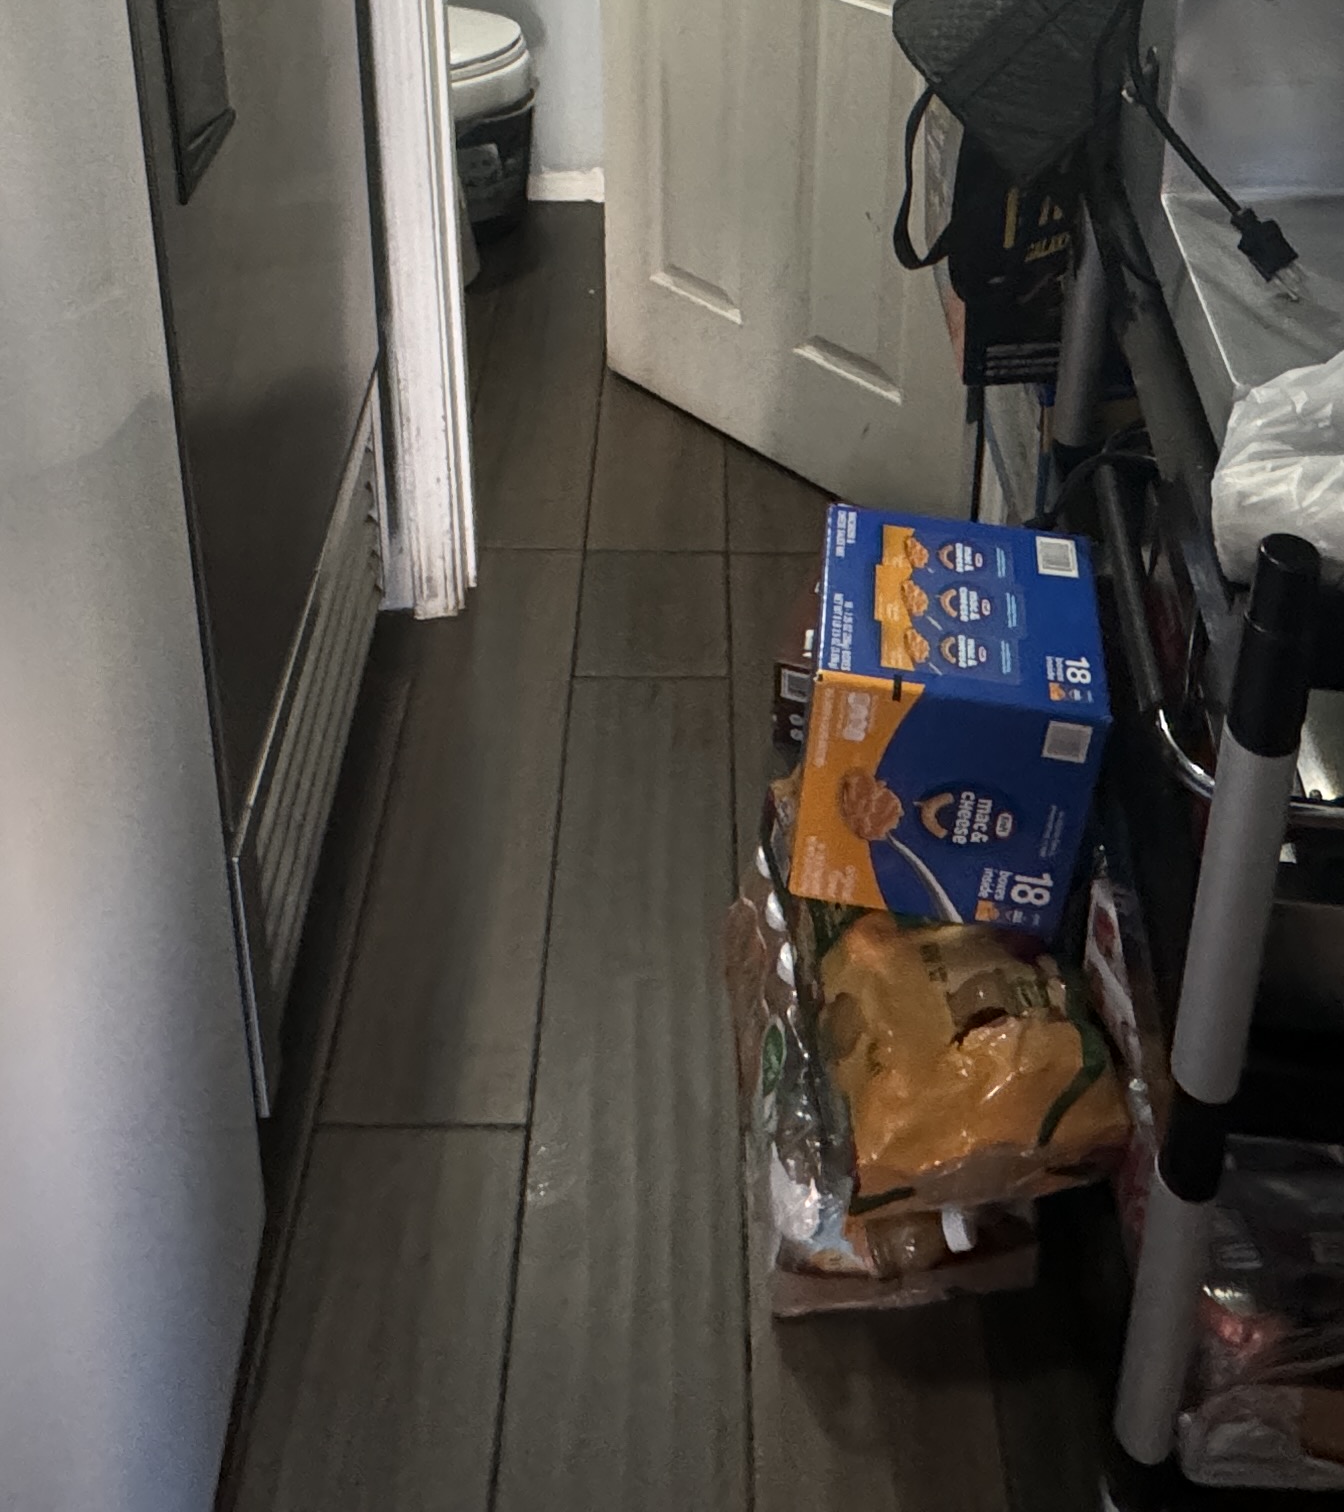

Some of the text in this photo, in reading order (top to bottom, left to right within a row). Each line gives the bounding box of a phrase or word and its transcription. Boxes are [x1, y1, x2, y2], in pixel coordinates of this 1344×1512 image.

[1065, 656, 1092, 684] 18
[978, 867, 996, 898] inside
[994, 870, 1013, 901] boxes
[1010, 873, 1054, 906] 18
